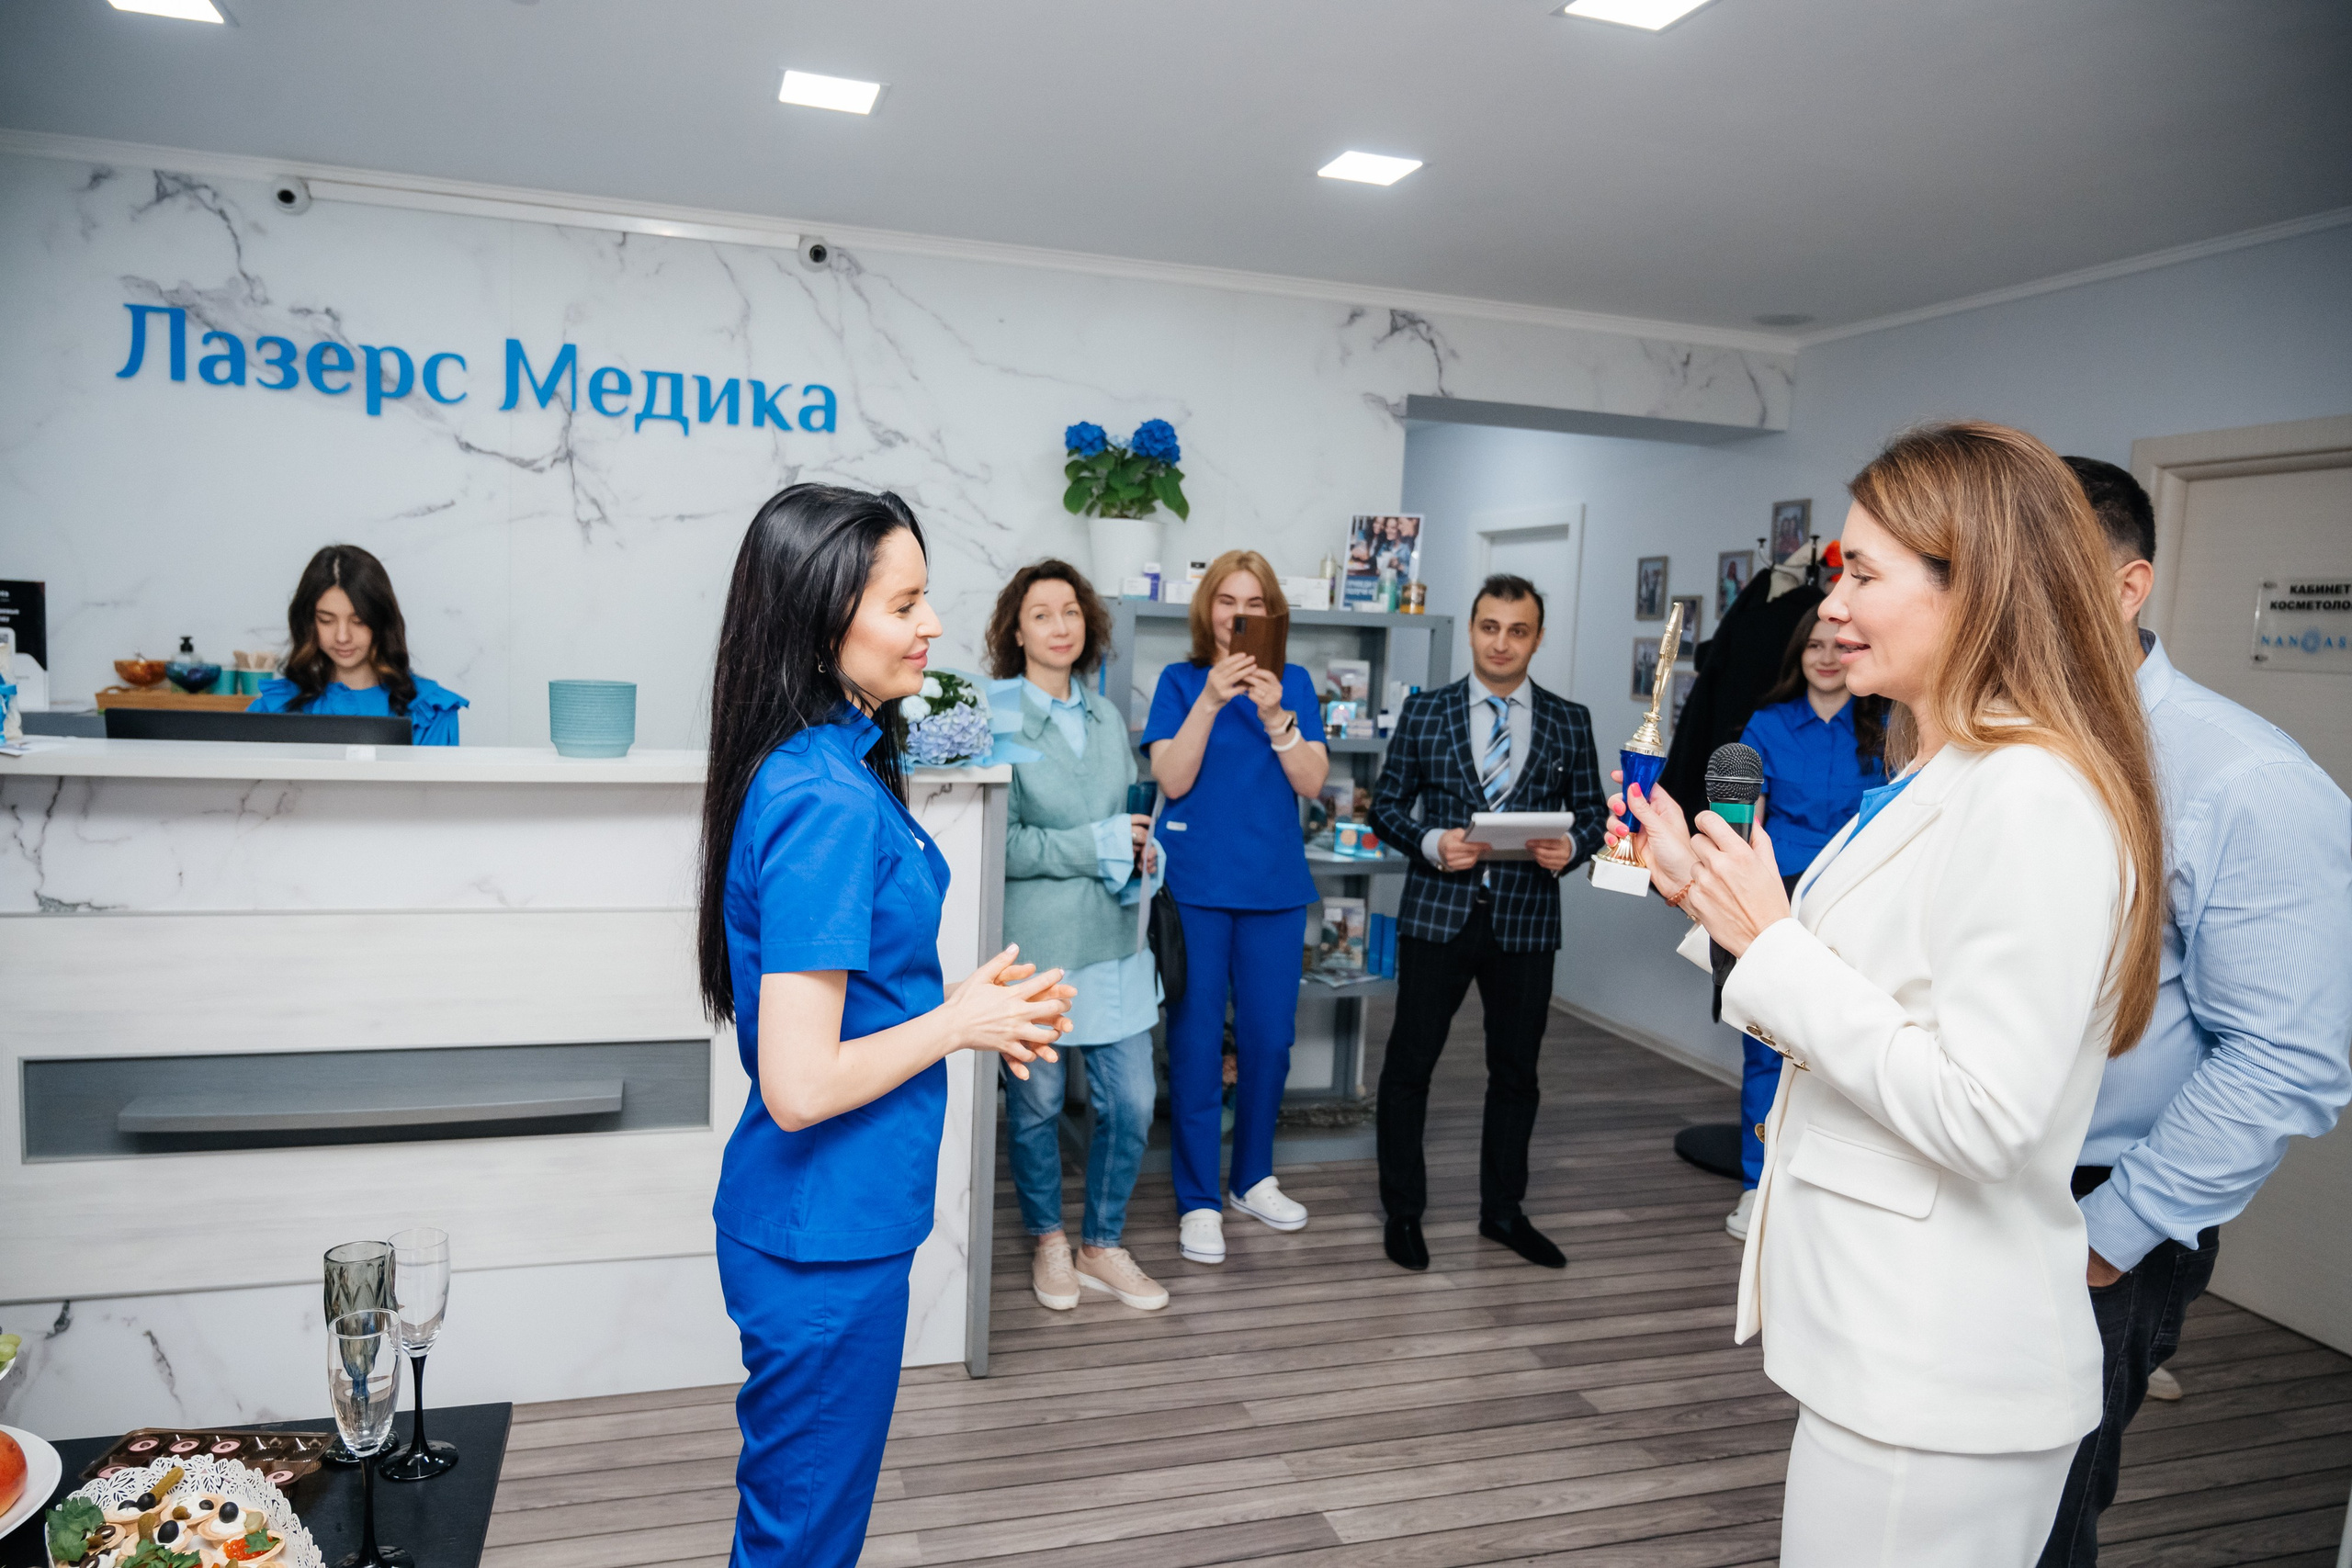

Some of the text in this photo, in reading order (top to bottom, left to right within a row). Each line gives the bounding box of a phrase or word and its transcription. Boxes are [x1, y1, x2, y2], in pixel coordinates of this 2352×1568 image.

[115, 303, 838, 437] Лазерс Медика
[2290, 583, 2351, 595] КАБИНЕТ
